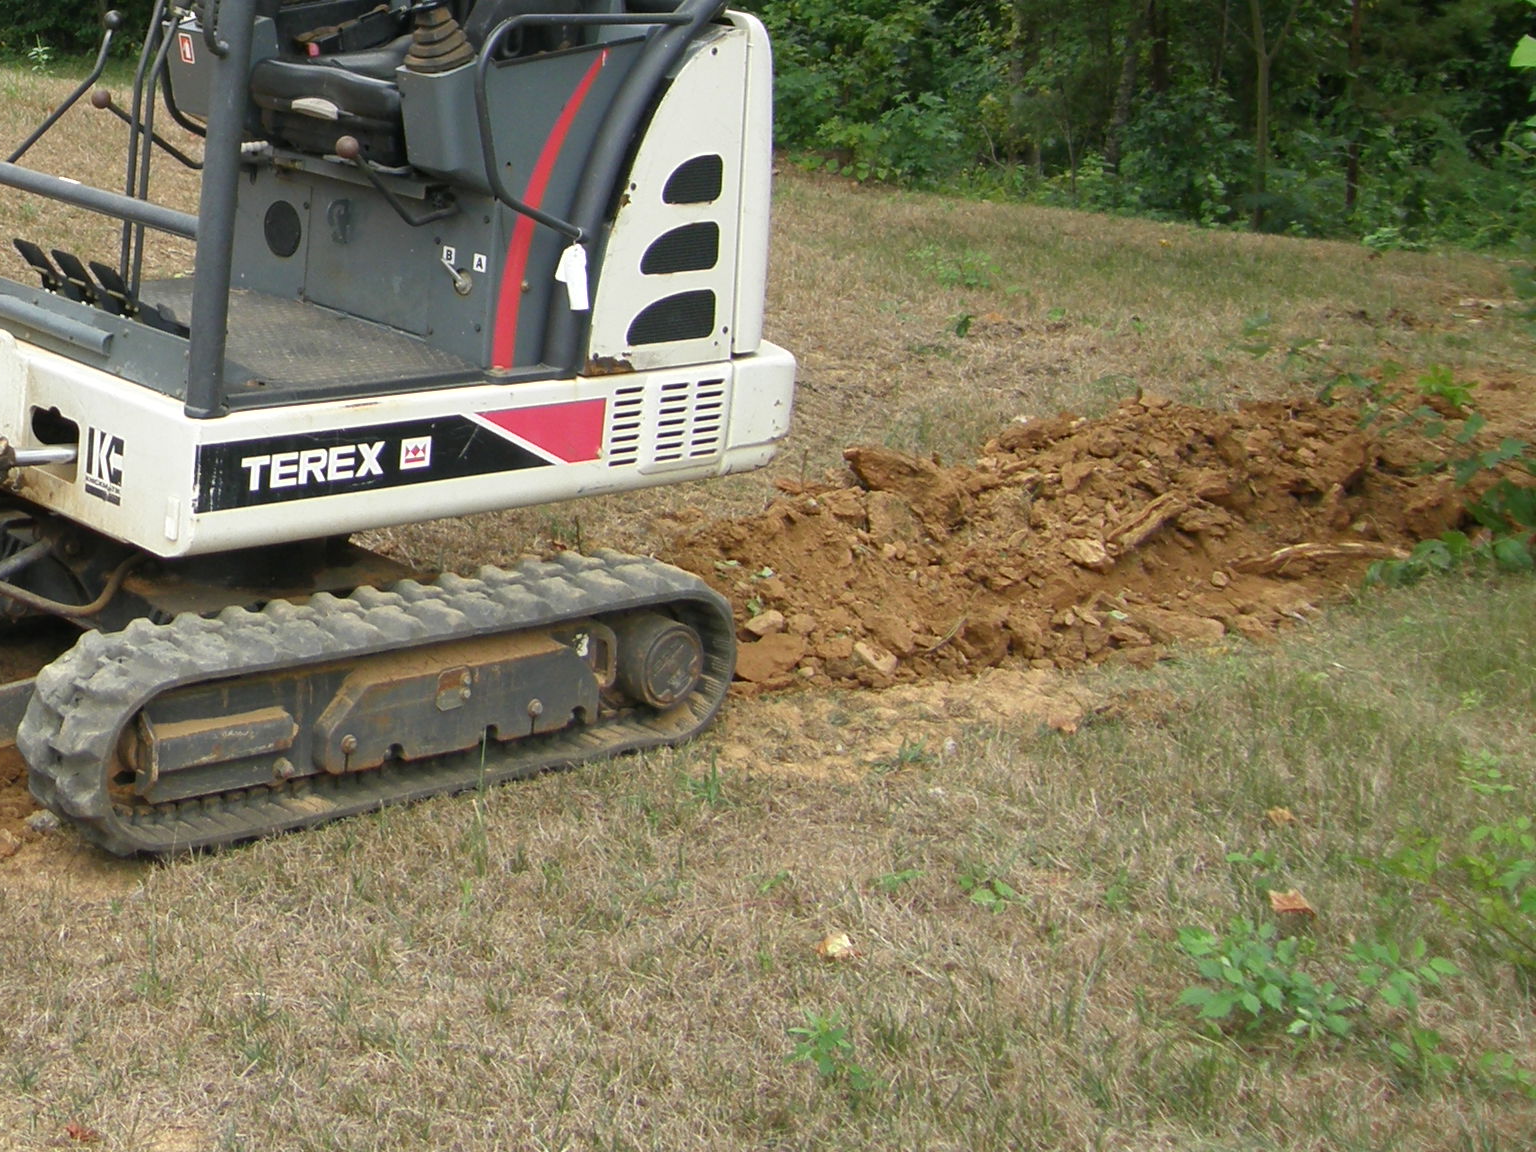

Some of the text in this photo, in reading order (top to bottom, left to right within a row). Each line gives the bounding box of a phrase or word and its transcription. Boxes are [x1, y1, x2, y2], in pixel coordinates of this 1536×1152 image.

[446, 249, 453, 260] B
[476, 257, 483, 269] A
[240, 440, 386, 492] TEREX
